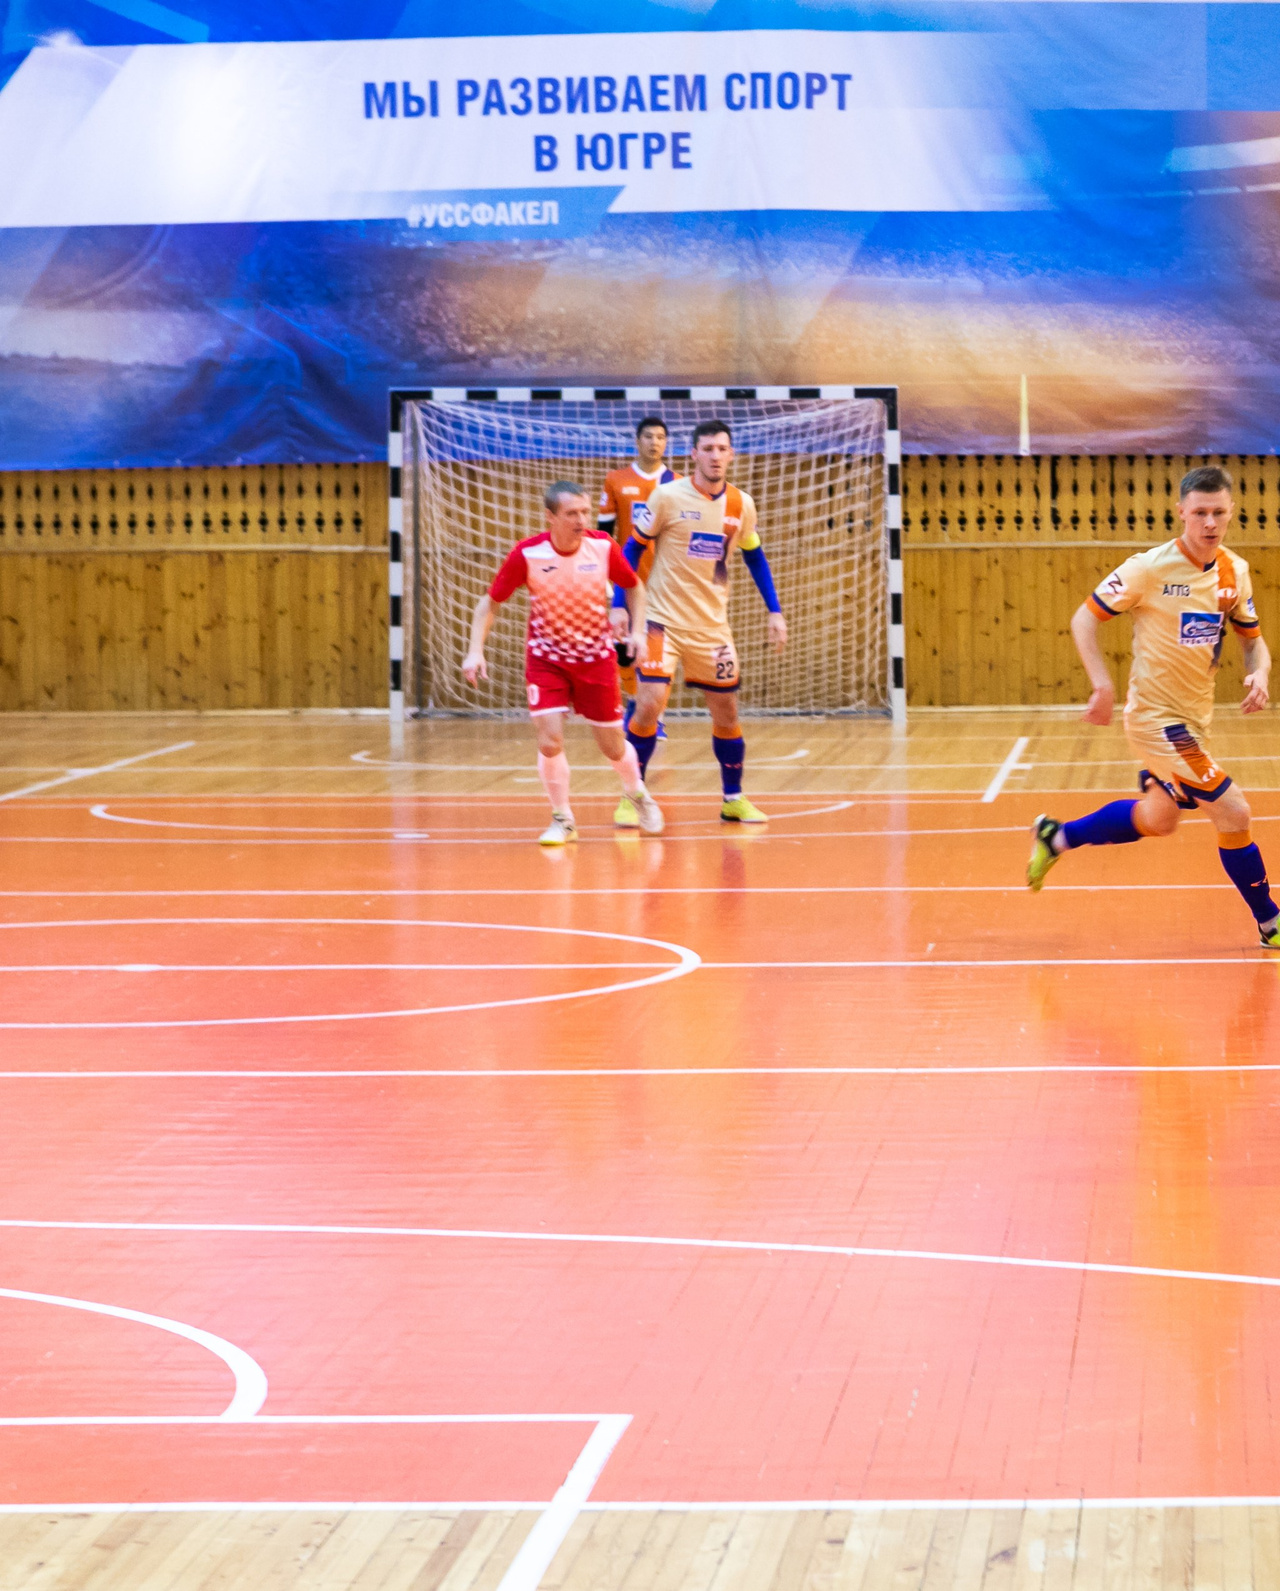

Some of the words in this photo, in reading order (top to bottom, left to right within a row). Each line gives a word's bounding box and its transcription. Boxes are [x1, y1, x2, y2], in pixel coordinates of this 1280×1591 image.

[363, 81, 439, 119] МЫ
[457, 74, 708, 116] РАЗВИВАЕМ
[724, 72, 852, 111] СПОРТ
[534, 134, 559, 172] В
[576, 131, 693, 171] ЮГРЕ
[406, 201, 559, 228] #УССФАКЕЛ
[715, 660, 735, 680] 22
